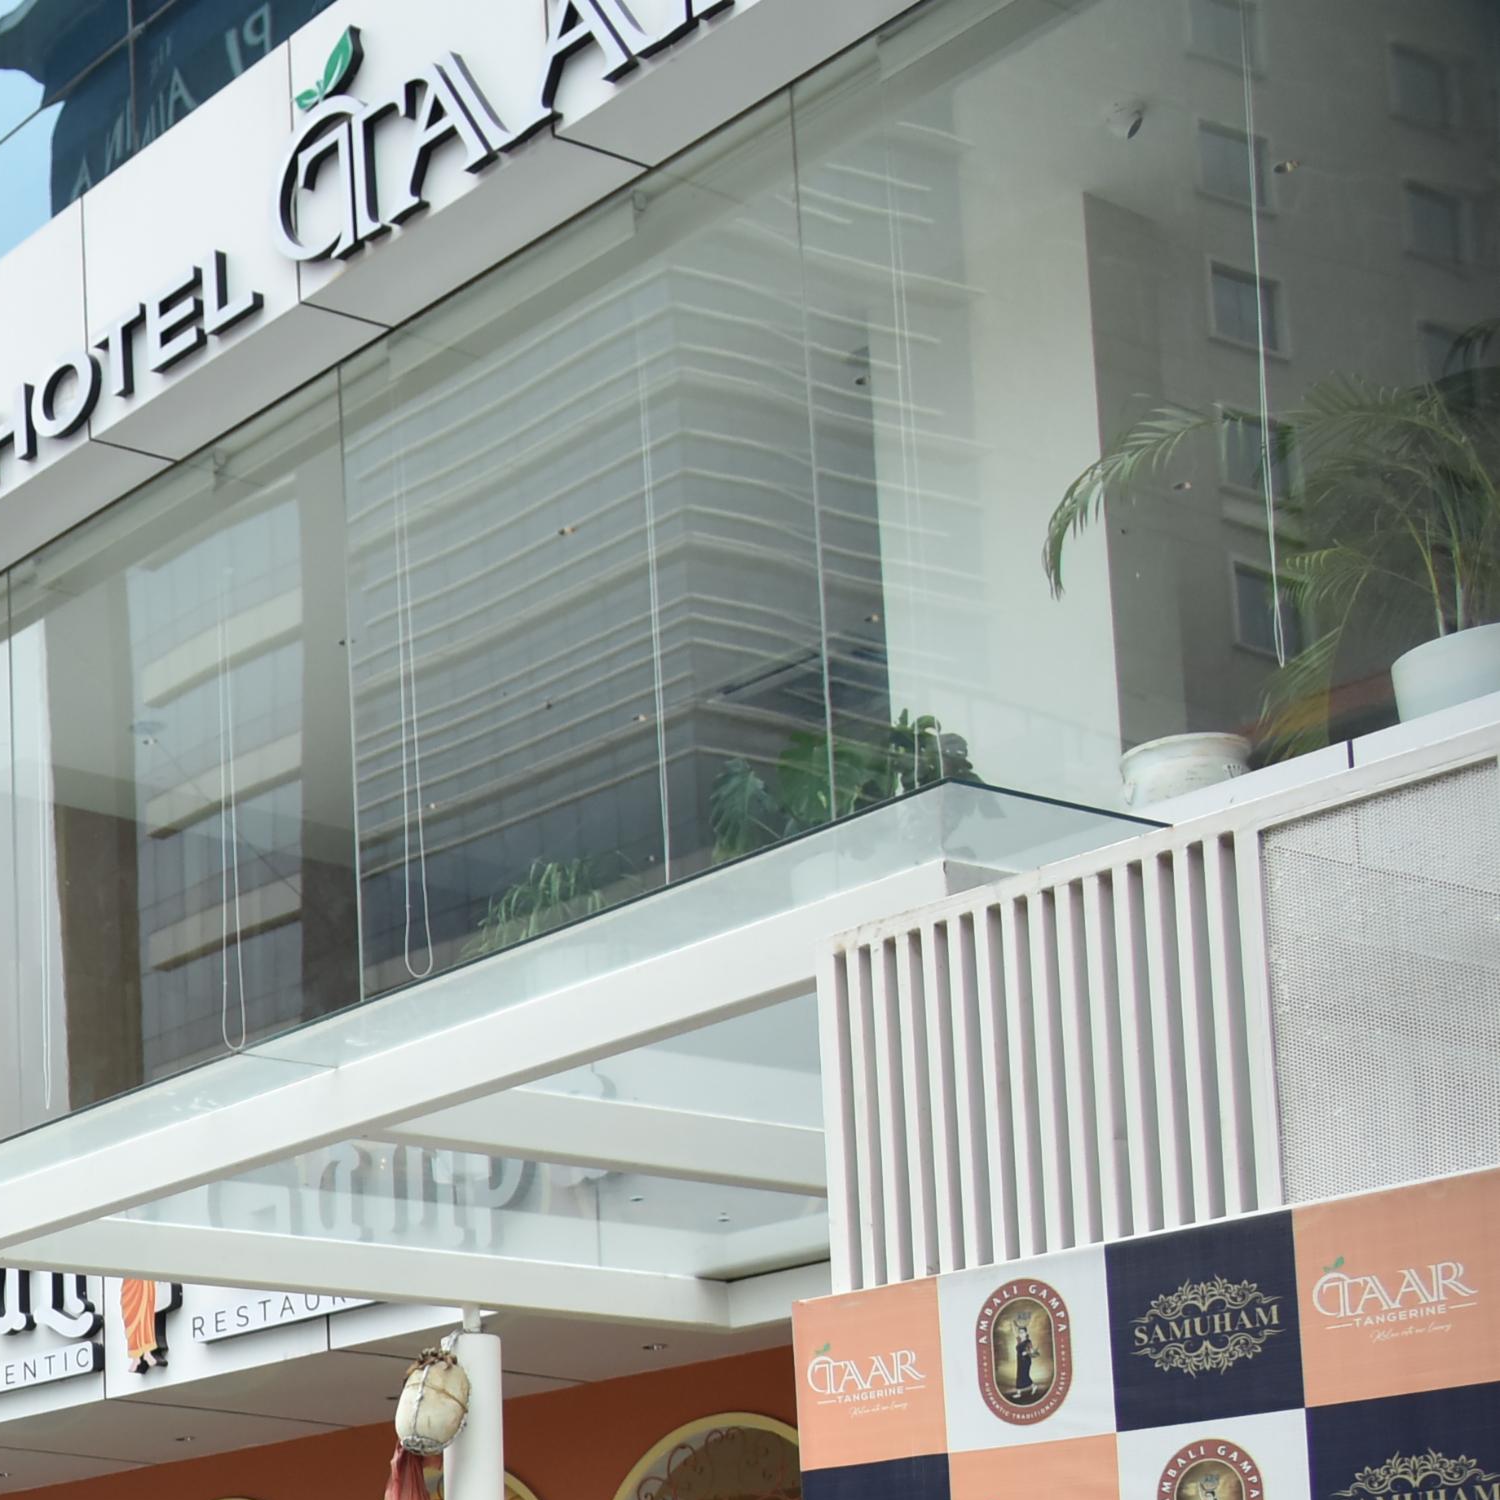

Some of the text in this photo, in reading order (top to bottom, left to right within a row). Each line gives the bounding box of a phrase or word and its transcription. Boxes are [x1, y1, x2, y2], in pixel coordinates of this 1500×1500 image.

[979, 1284, 1067, 1344] AMBALI GAMPA
[1134, 1304, 1281, 1346] SAMUHAM
[1354, 1303, 1447, 1328] TANGERINE
[837, 1386, 904, 1403] TANGERINE
[1216, 1445, 1260, 1498] GAMPA
